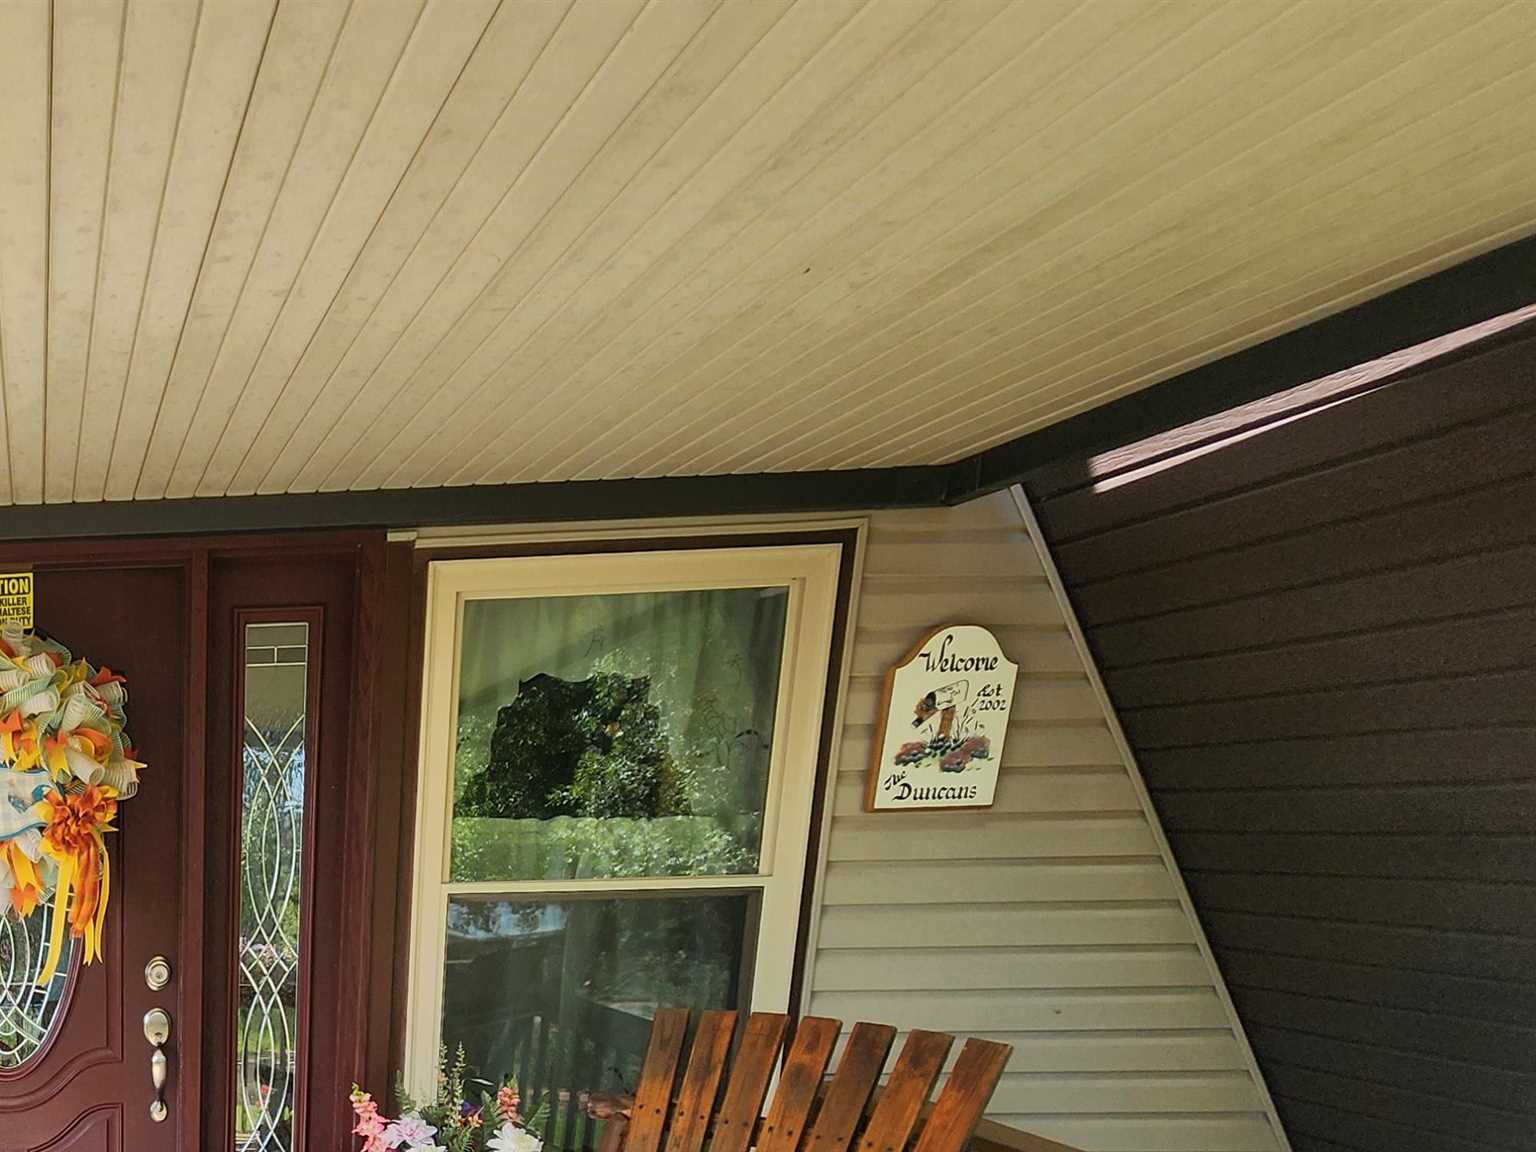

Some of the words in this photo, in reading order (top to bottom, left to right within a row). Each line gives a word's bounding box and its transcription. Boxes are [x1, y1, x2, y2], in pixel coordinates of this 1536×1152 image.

[0, 597, 27, 607] KILLER
[919, 634, 998, 673] Welcome
[979, 699, 1008, 712] 2002
[884, 770, 907, 791] The
[892, 782, 977, 801] Duncans
